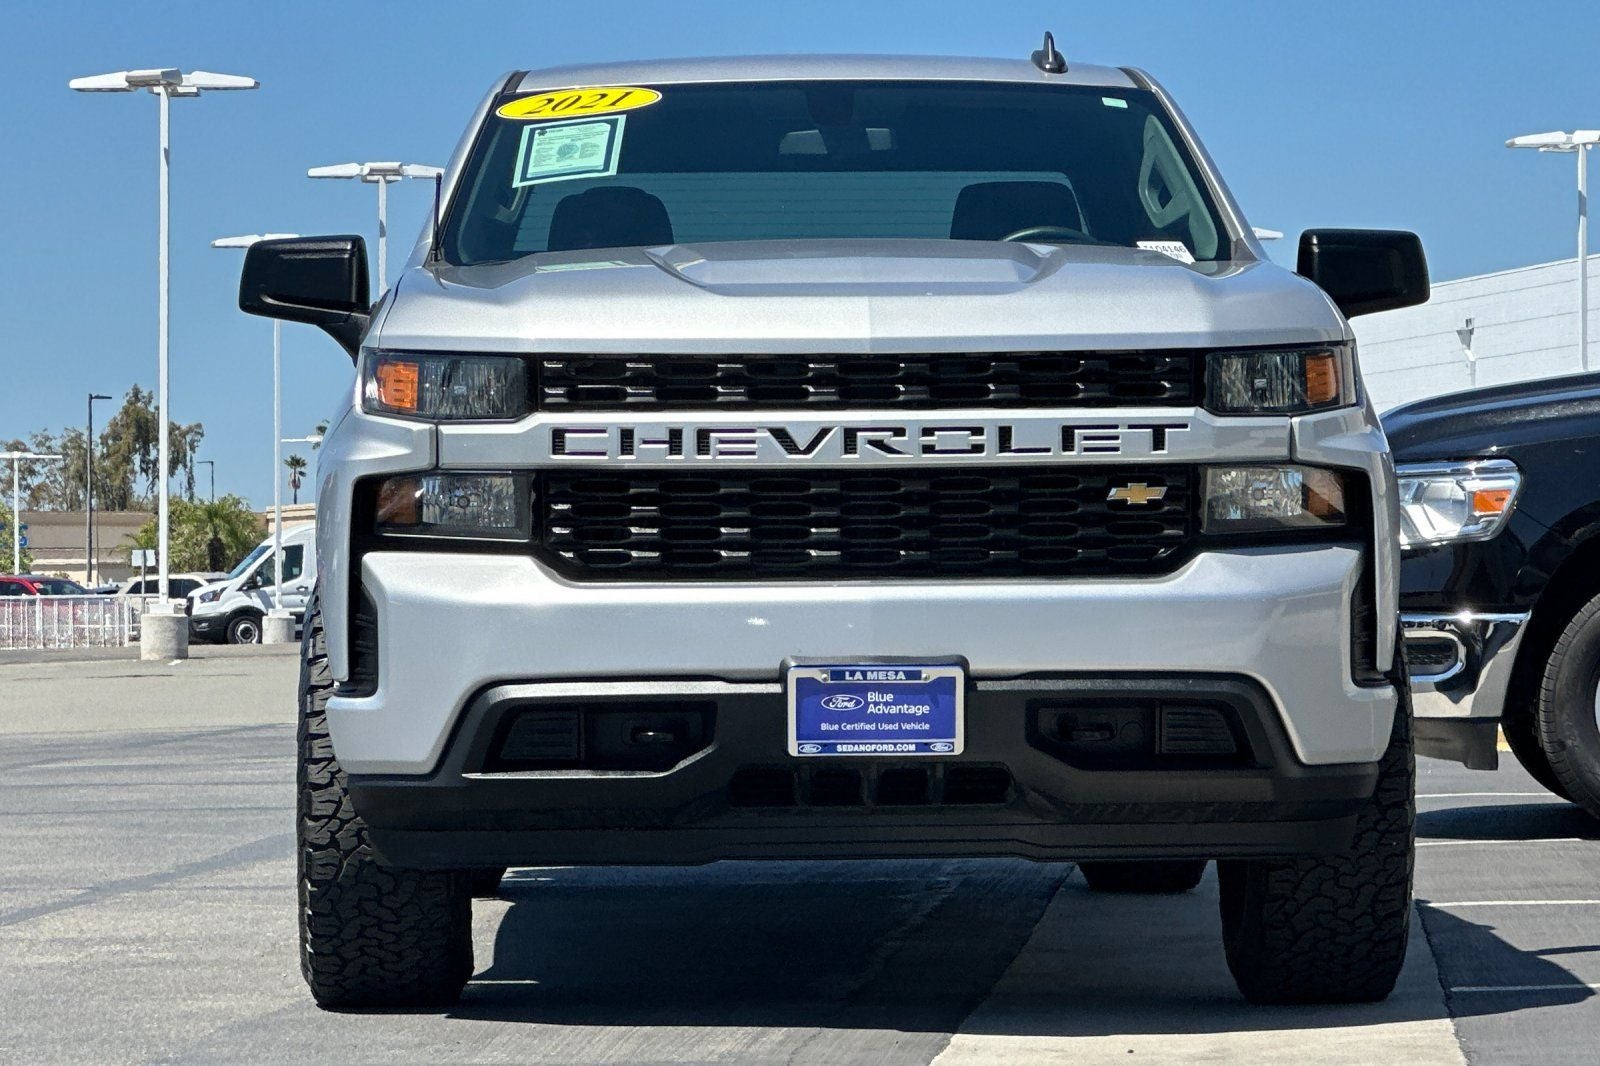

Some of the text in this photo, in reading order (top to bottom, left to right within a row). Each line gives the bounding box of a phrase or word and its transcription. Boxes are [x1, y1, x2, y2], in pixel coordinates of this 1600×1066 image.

[521, 91, 635, 115] 2021
[550, 424, 1191, 459] CHEVROLET
[845, 671, 906, 680] LA MESA
[867, 691, 894, 702] Blue
[867, 703, 930, 716] Advantage
[820, 722, 930, 731] Blue Certified Used Vehicle
[836, 743, 916, 752] SEDANOFORD.COM
